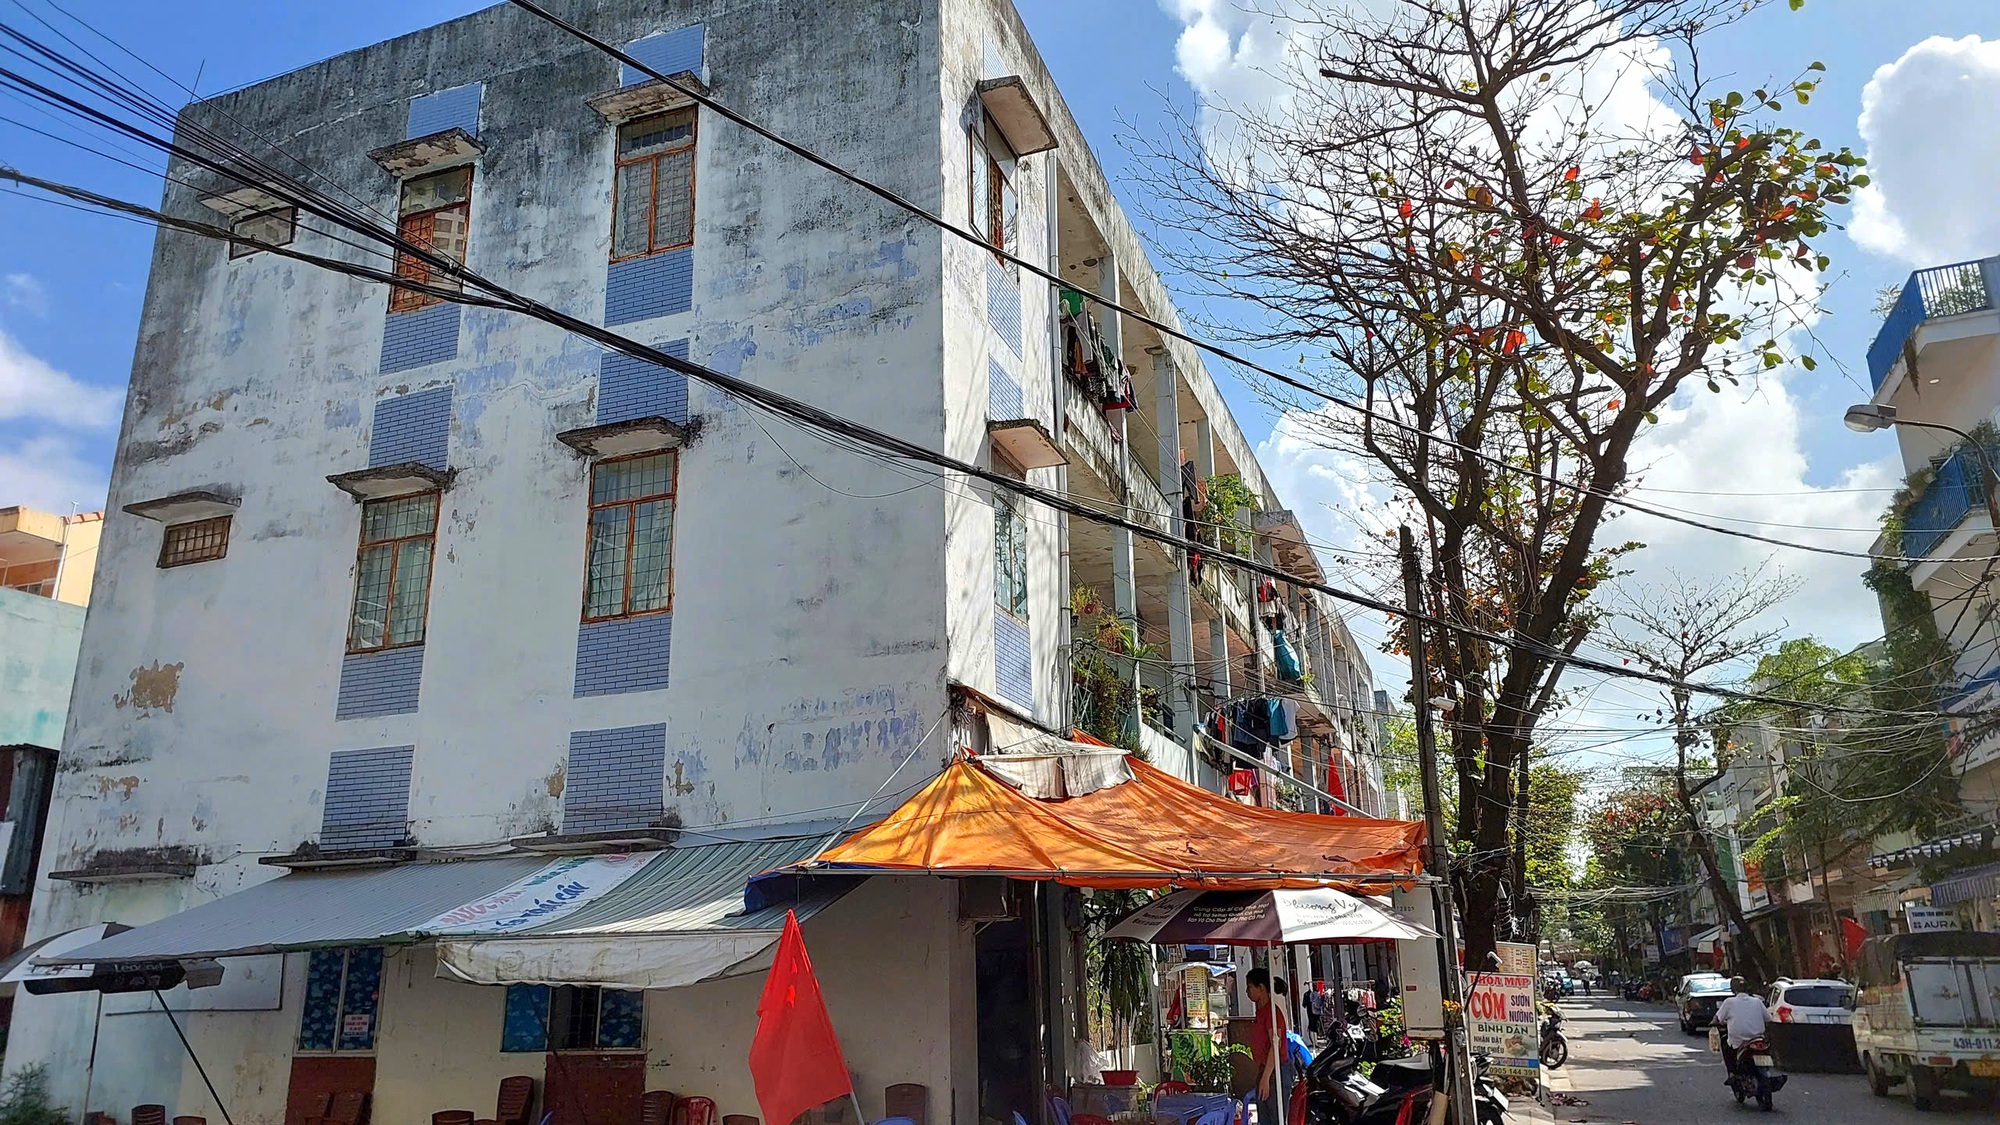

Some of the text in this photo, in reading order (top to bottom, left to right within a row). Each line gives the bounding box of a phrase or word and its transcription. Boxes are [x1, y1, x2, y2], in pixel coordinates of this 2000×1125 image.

[1924, 920, 1958, 928] AURA
[1471, 986, 1506, 1020] CƠM
[1478, 1022, 1529, 1034] BÌNH DÂN
[1489, 1067, 1507, 1075] 0905
